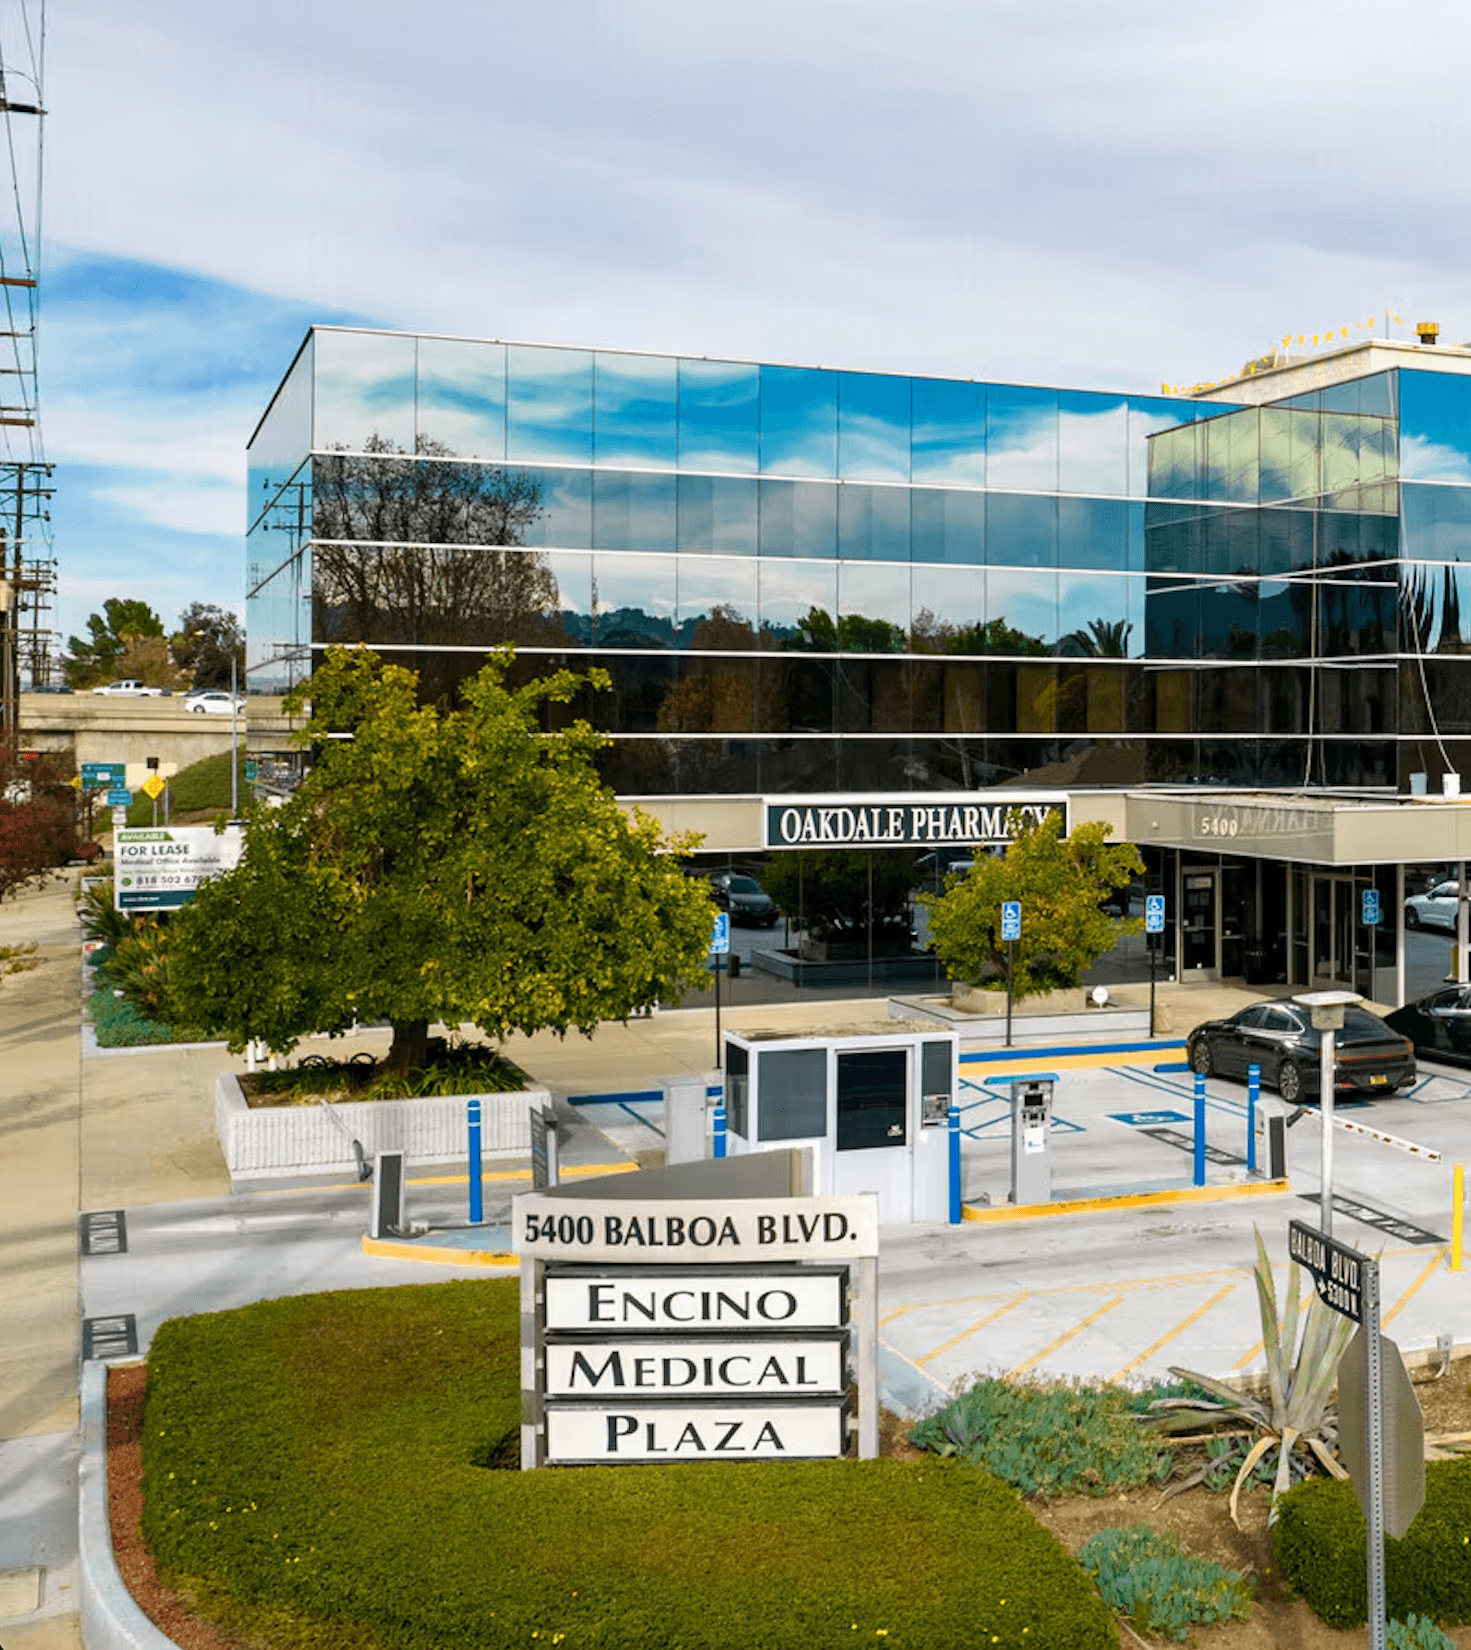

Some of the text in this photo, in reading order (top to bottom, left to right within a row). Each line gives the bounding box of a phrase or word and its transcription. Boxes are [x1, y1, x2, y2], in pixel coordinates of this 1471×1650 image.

[780, 807, 905, 843] OAKDALE
[1201, 817, 1238, 837] 5400
[121, 844, 190, 856] FOR LEASE
[182, 856, 220, 864] Available
[136, 876, 157, 885] 818
[161, 875, 180, 884] 502
[525, 1213, 857, 1246] 5400 BALBOA BLVD.
[1291, 1228, 1326, 1273] BALBOA
